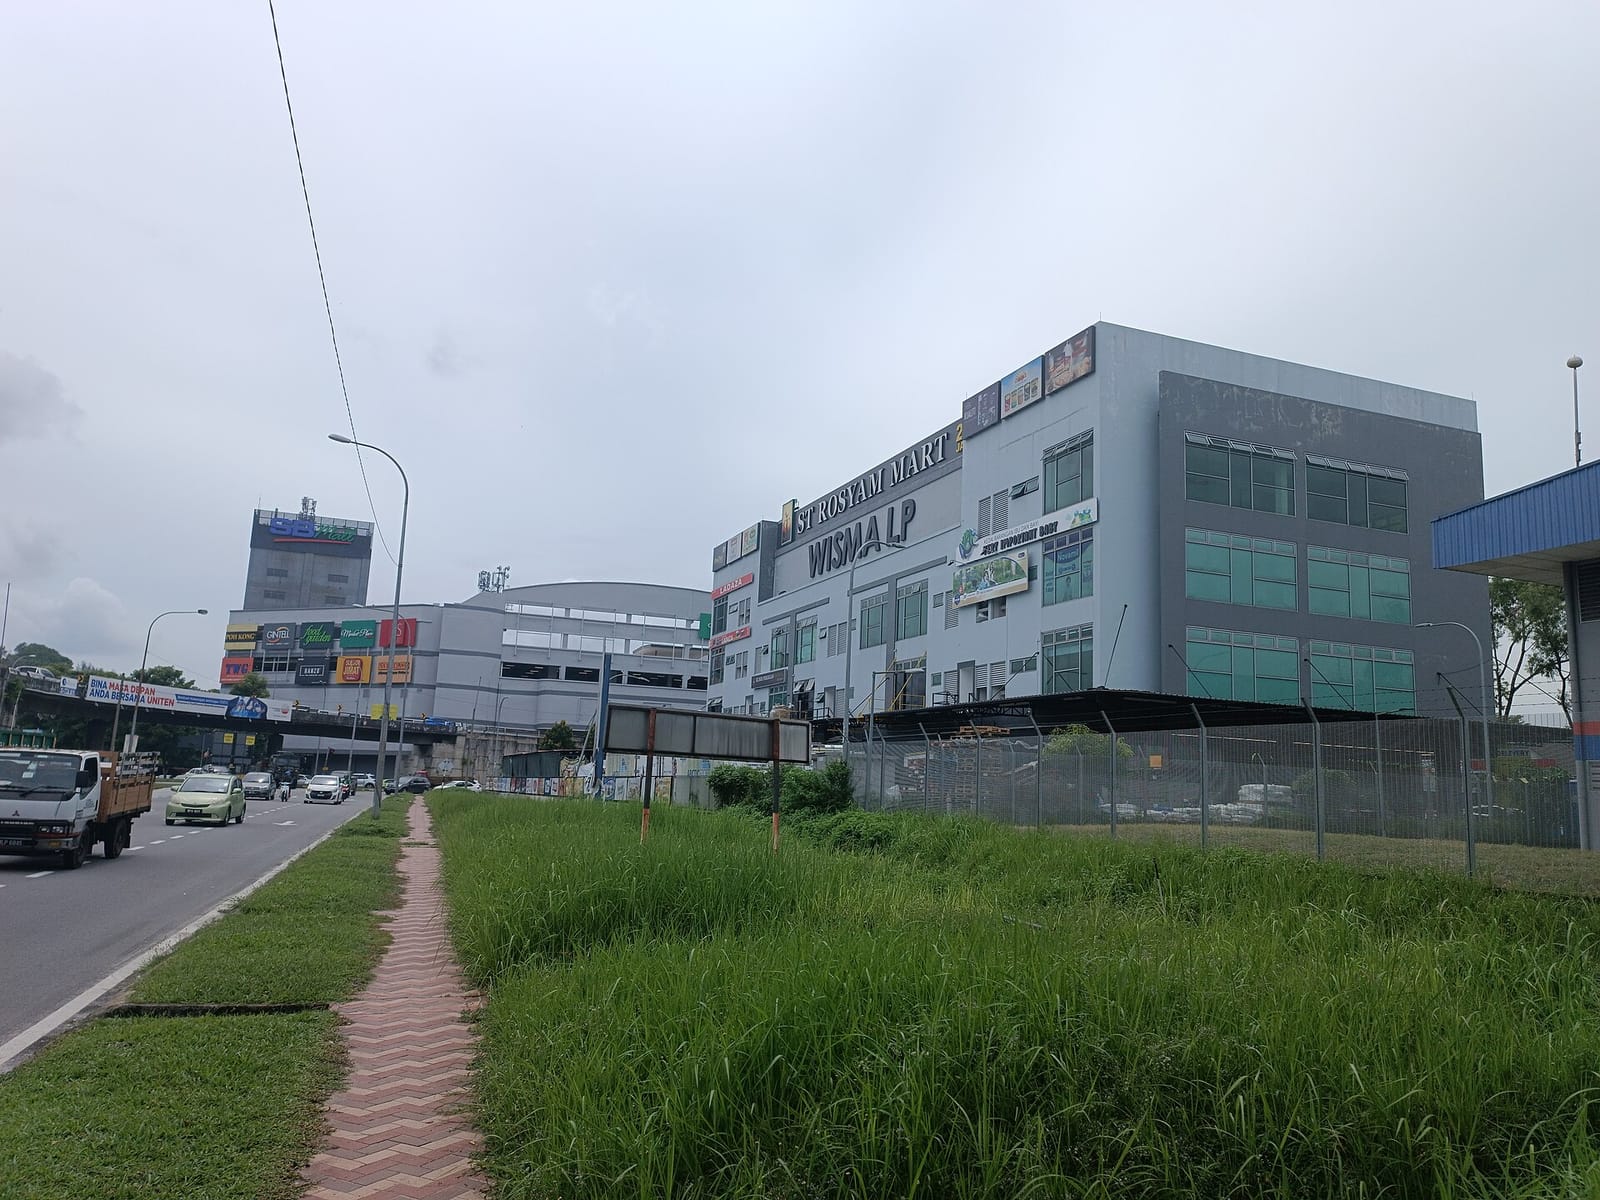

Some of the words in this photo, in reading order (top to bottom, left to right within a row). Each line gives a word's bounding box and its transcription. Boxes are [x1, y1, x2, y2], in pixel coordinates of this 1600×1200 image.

[796, 507, 815, 534] ST
[818, 468, 885, 525] ROSYAM
[889, 433, 949, 487] MART
[808, 515, 882, 579] WISMA
[886, 499, 917, 544] LP
[1000, 528, 1038, 550] IMPORTANT
[1039, 521, 1059, 537] BABY
[225, 663, 249, 673] TWG
[89, 687, 110, 699] ANDA
[111, 691, 145, 703] BERSAMA
[147, 696, 175, 707] UNITEN
[90, 679, 108, 688] BINA
[130, 685, 156, 696] DEPAN
